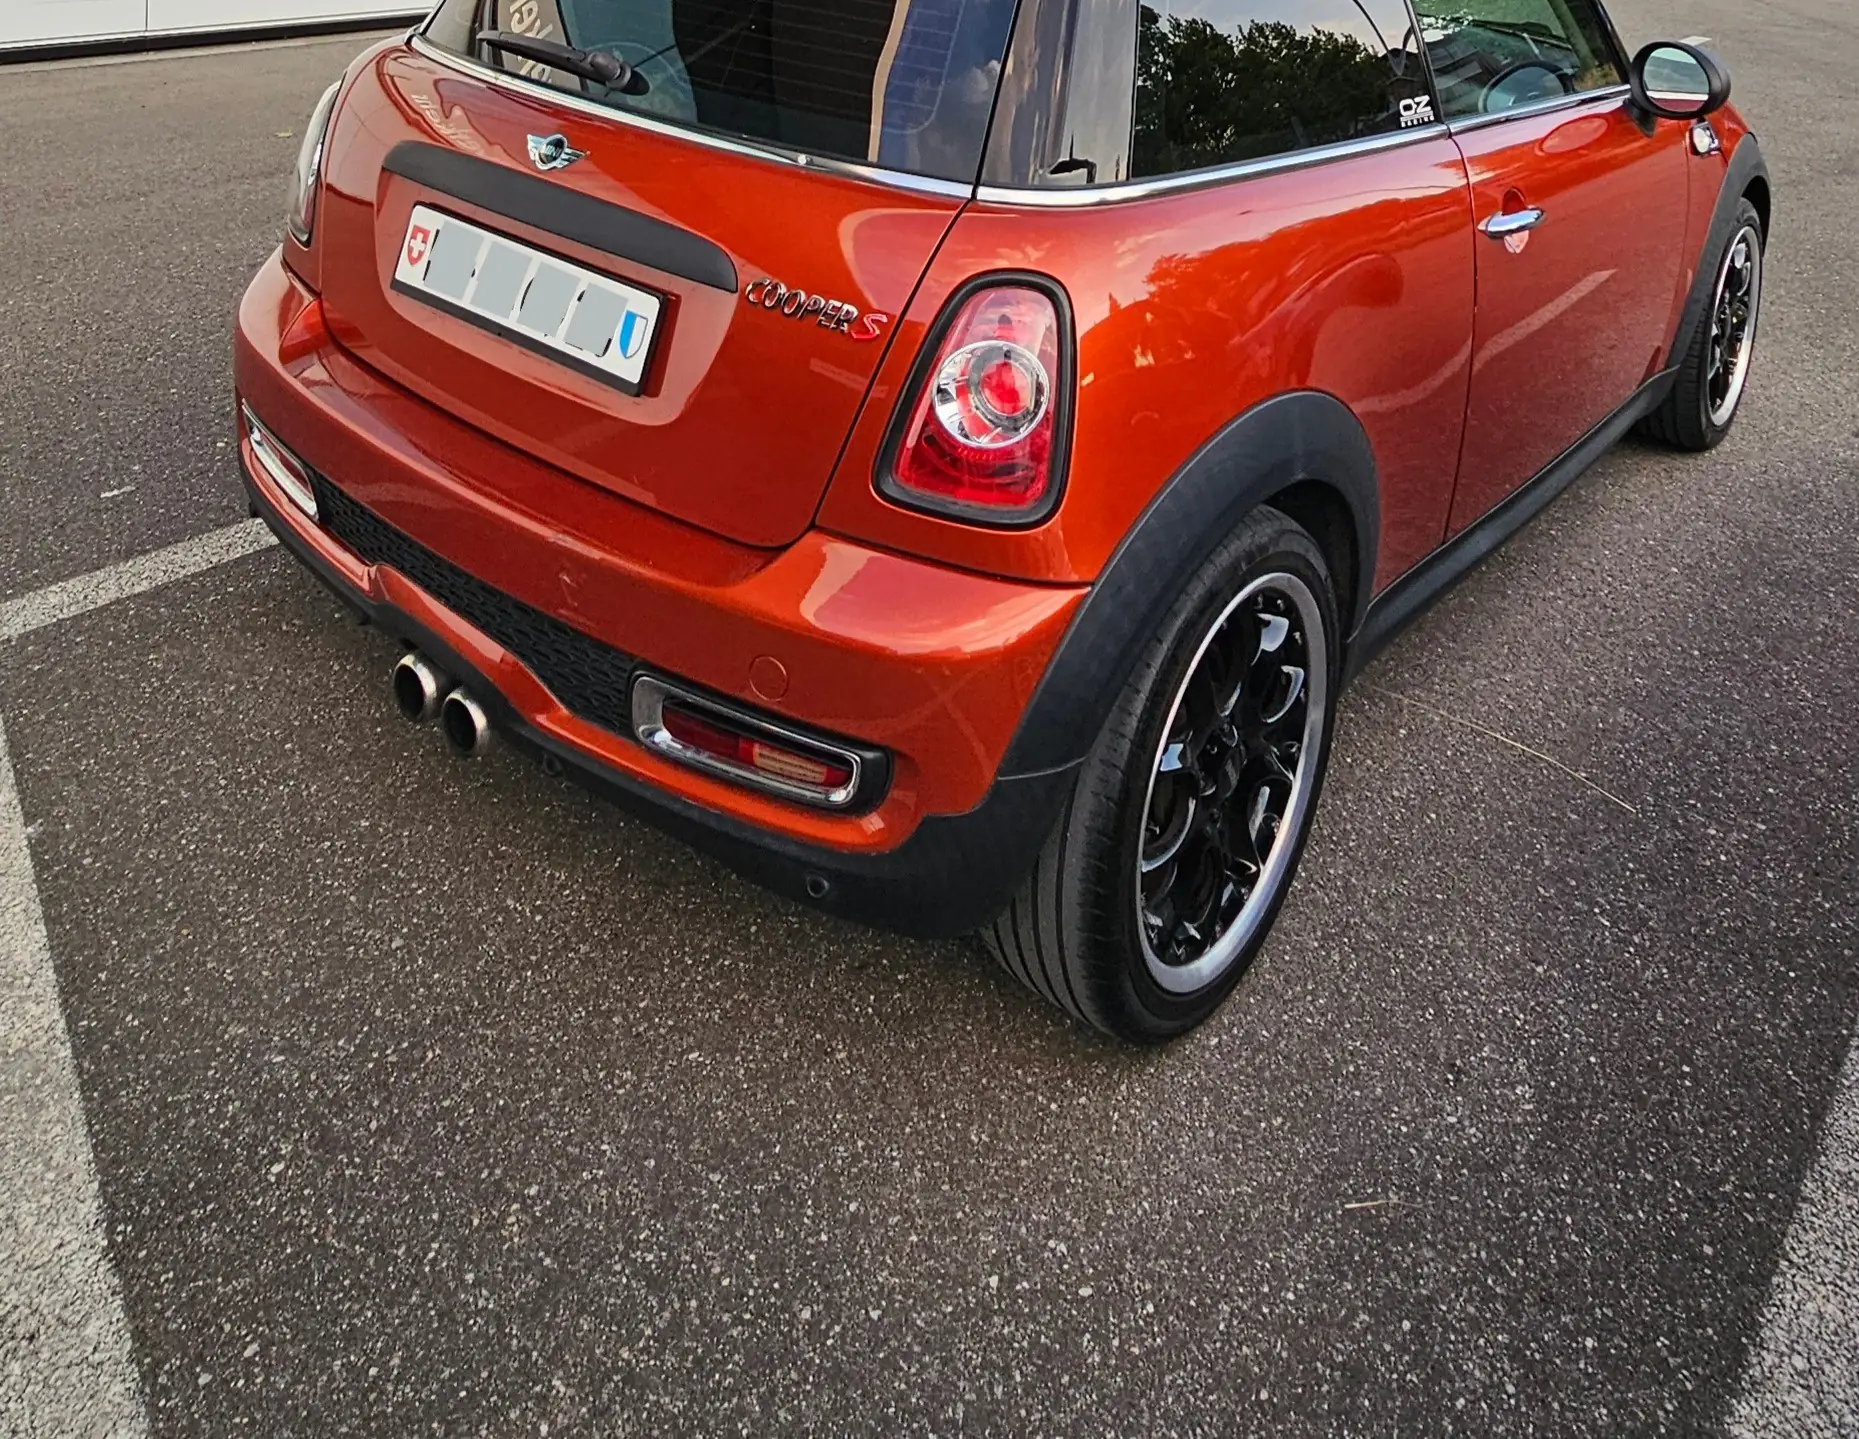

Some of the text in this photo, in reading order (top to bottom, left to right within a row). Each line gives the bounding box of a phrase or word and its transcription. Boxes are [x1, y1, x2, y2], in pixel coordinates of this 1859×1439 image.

[1400, 95, 1431, 117] OZ
[745, 276, 888, 339] COOPER S
